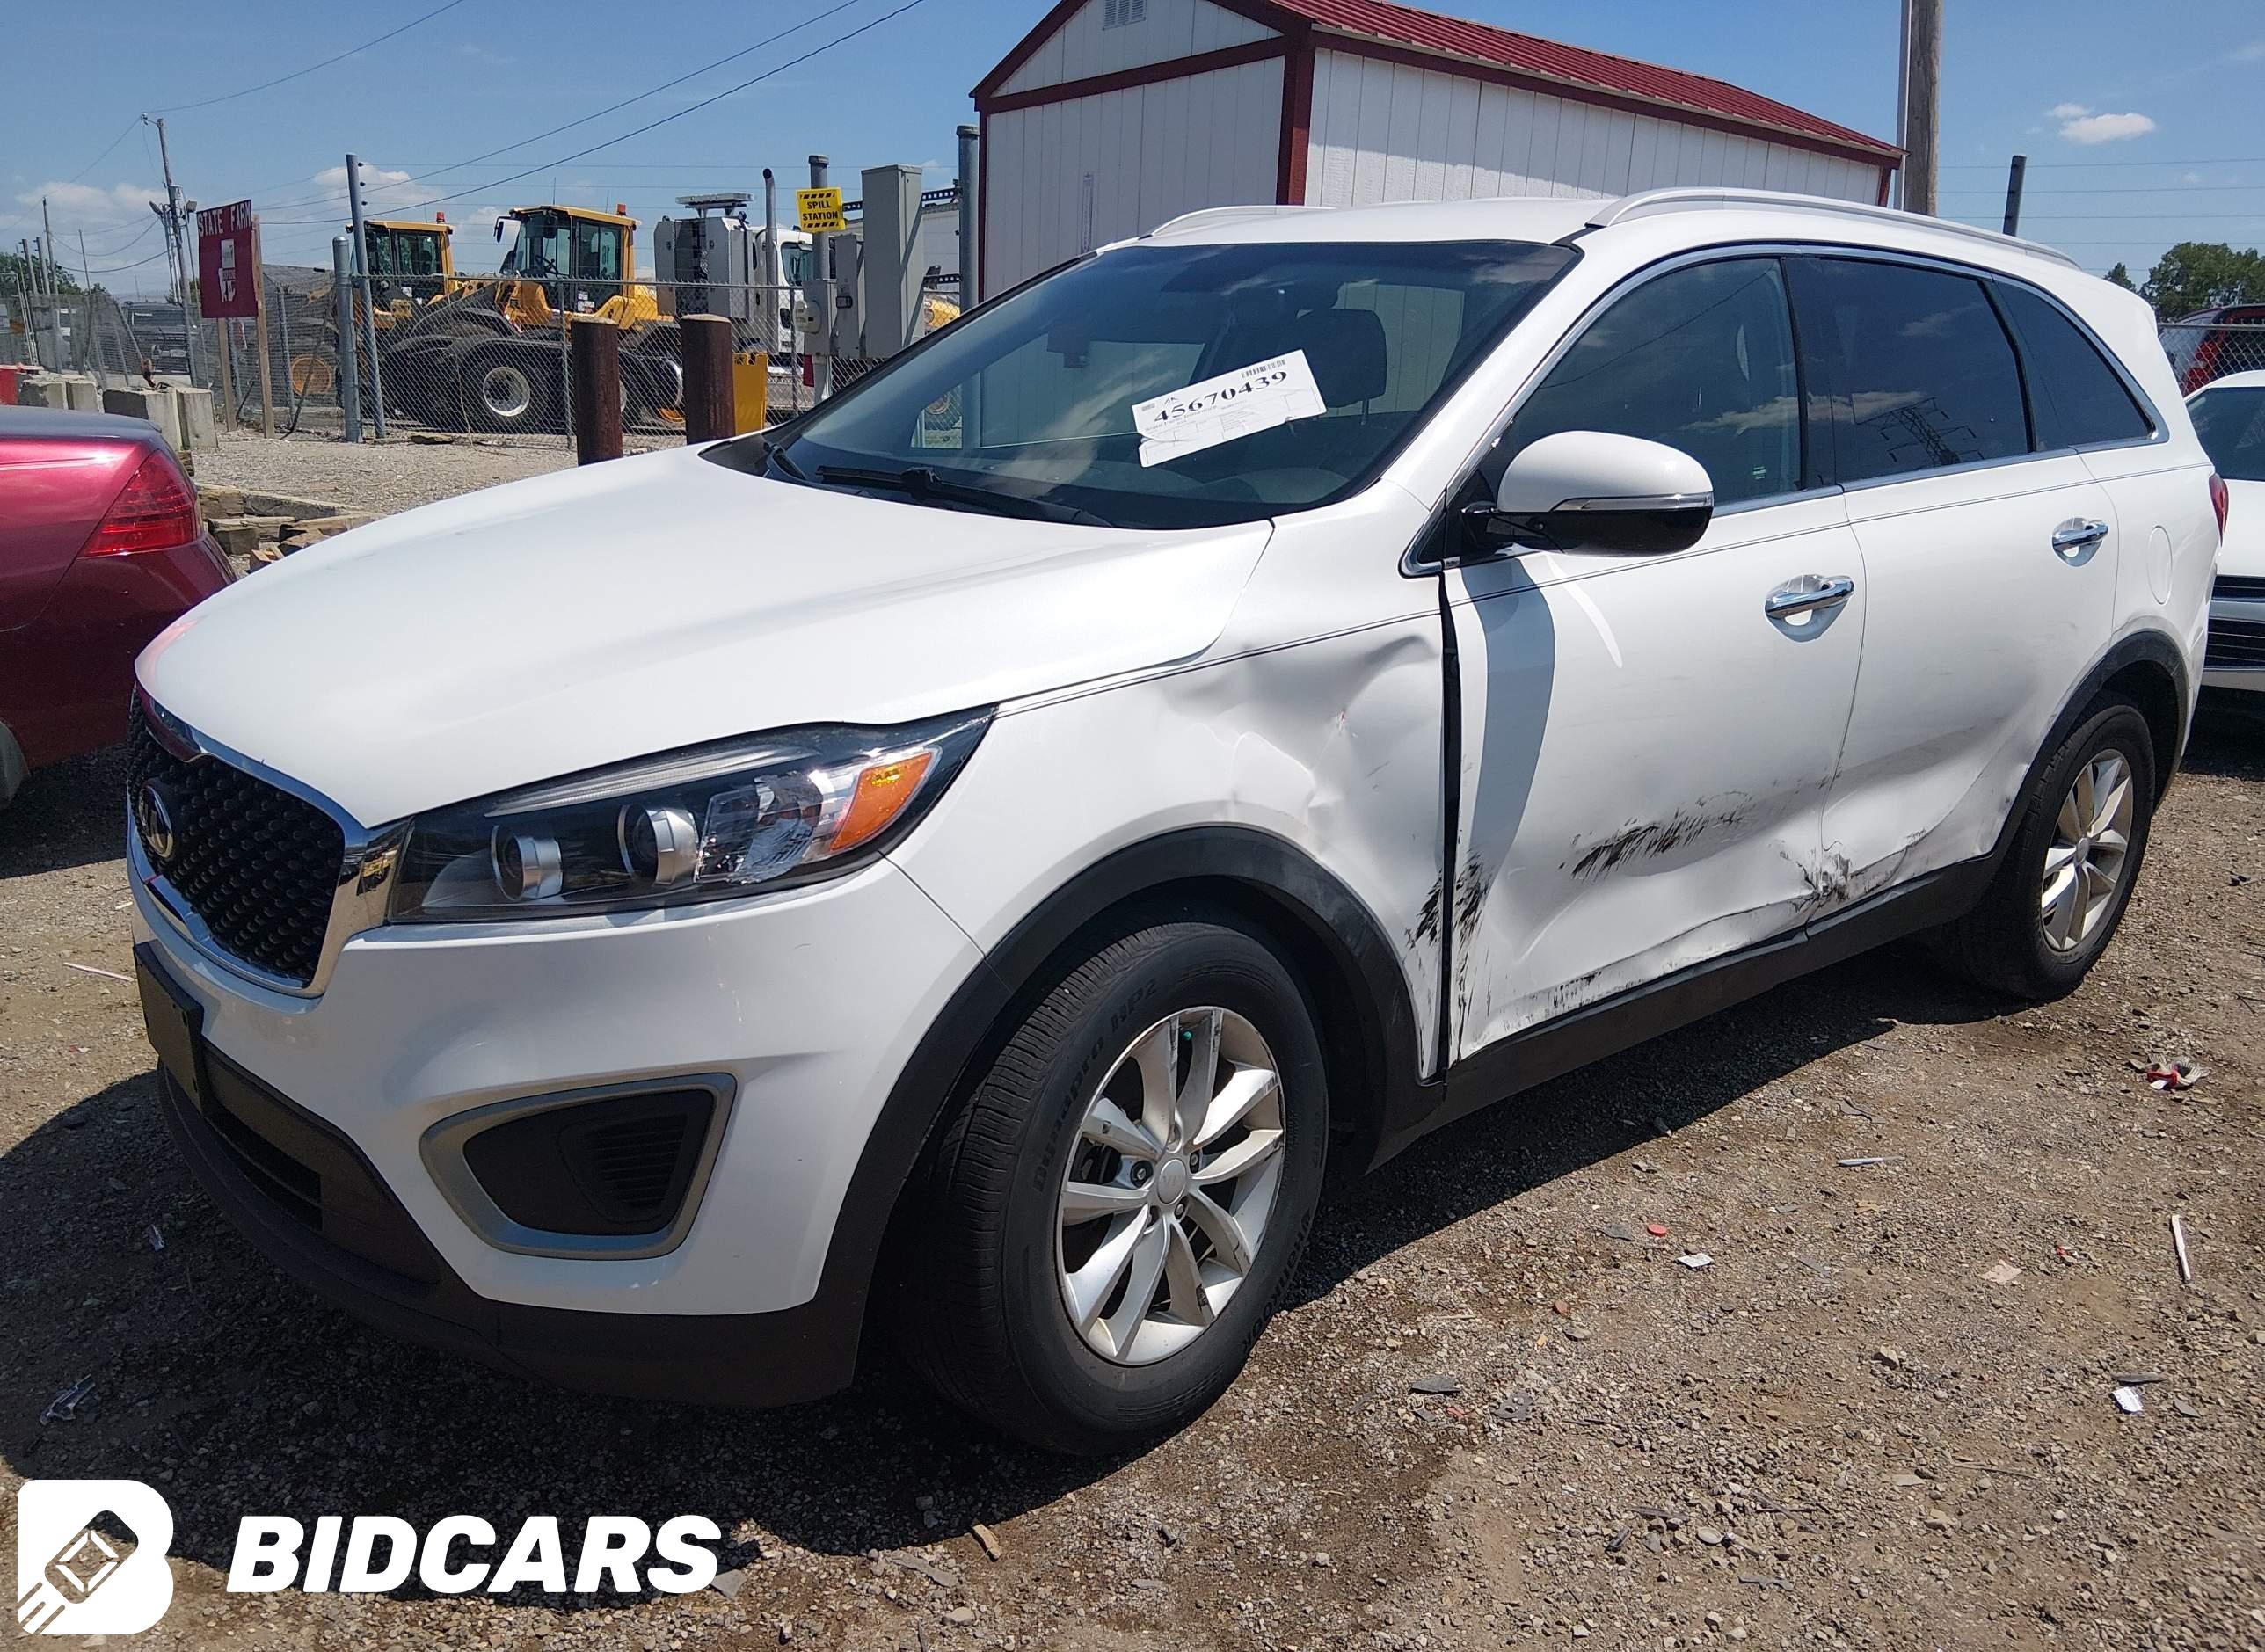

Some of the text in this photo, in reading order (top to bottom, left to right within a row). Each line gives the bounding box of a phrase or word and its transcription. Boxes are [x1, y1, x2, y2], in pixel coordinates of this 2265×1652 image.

[802, 211, 838, 221] STATION
[806, 200, 832, 210] SPILL
[198, 200, 251, 237] STATE FARM
[1154, 371, 1287, 422] 45670439
